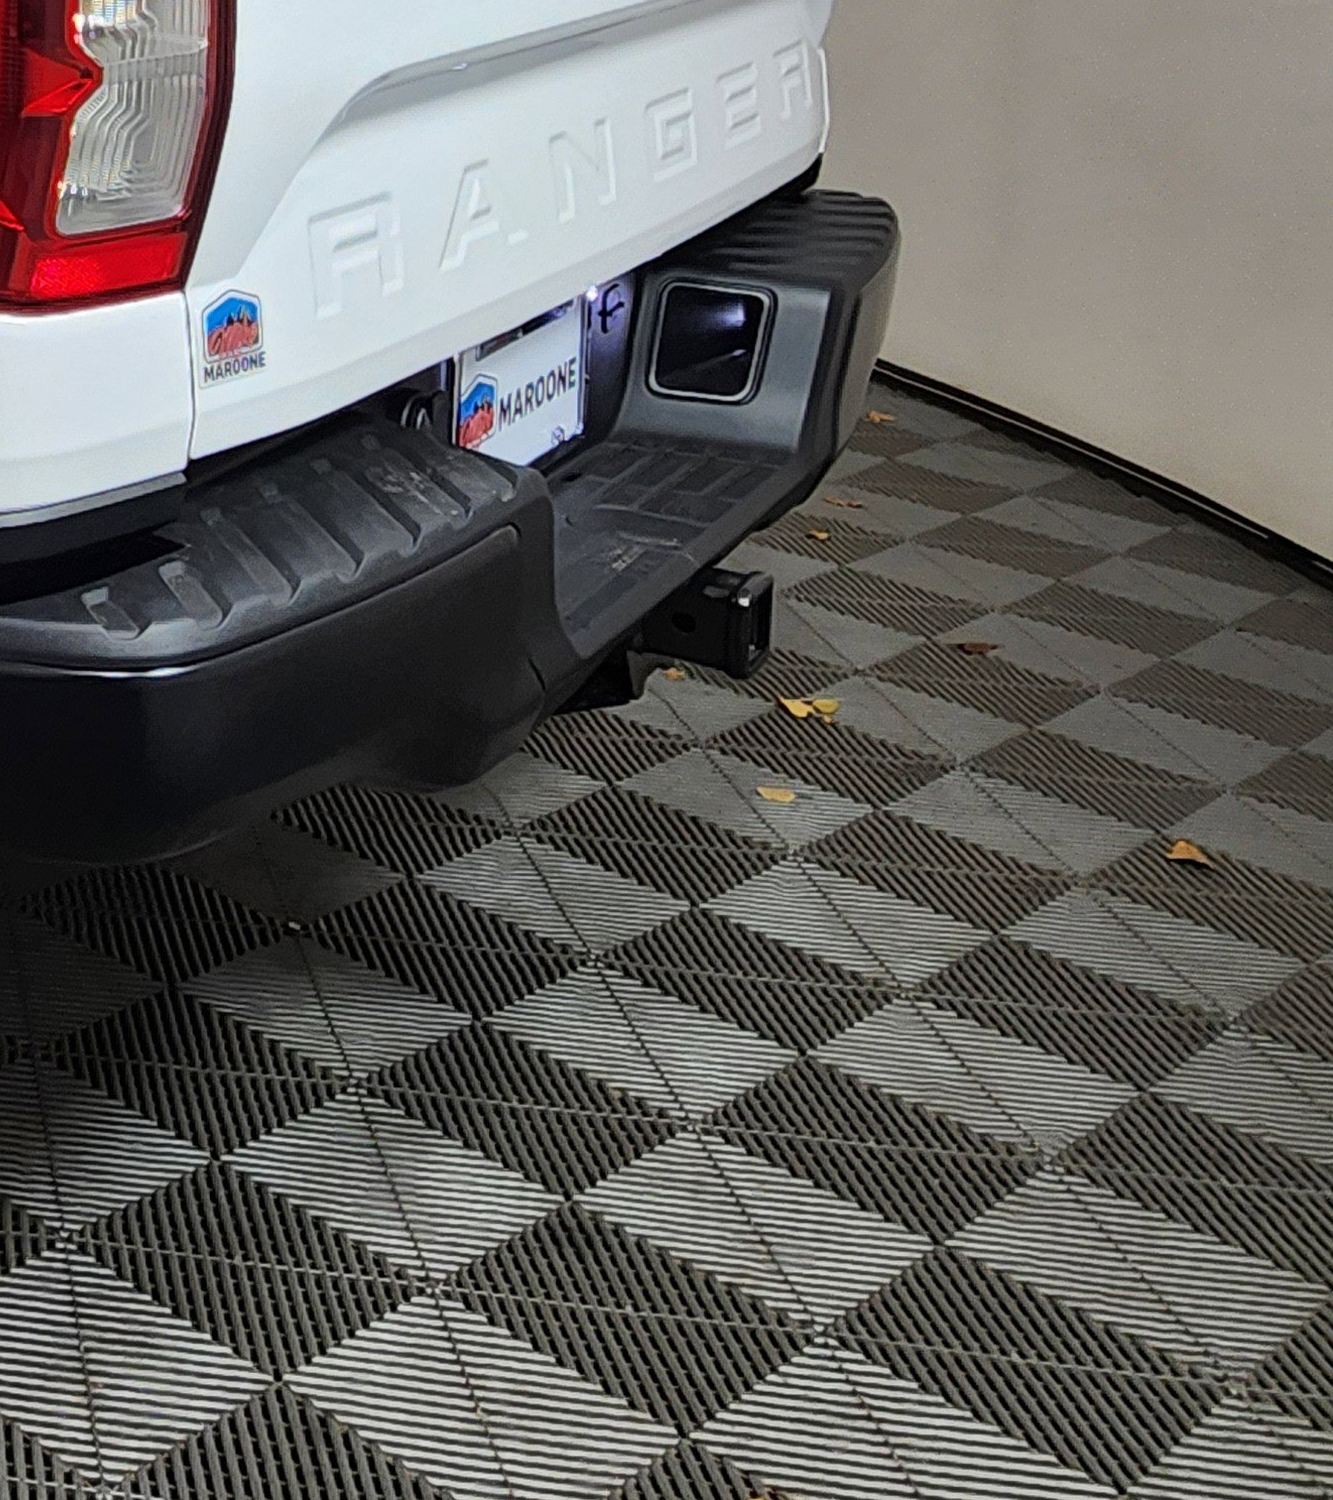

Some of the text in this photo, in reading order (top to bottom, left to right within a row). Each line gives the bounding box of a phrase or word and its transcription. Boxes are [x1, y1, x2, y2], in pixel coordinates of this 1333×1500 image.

[307, 38, 814, 319] RANGER
[203, 351, 267, 383] MAROONE
[499, 357, 577, 431] MAROONE
